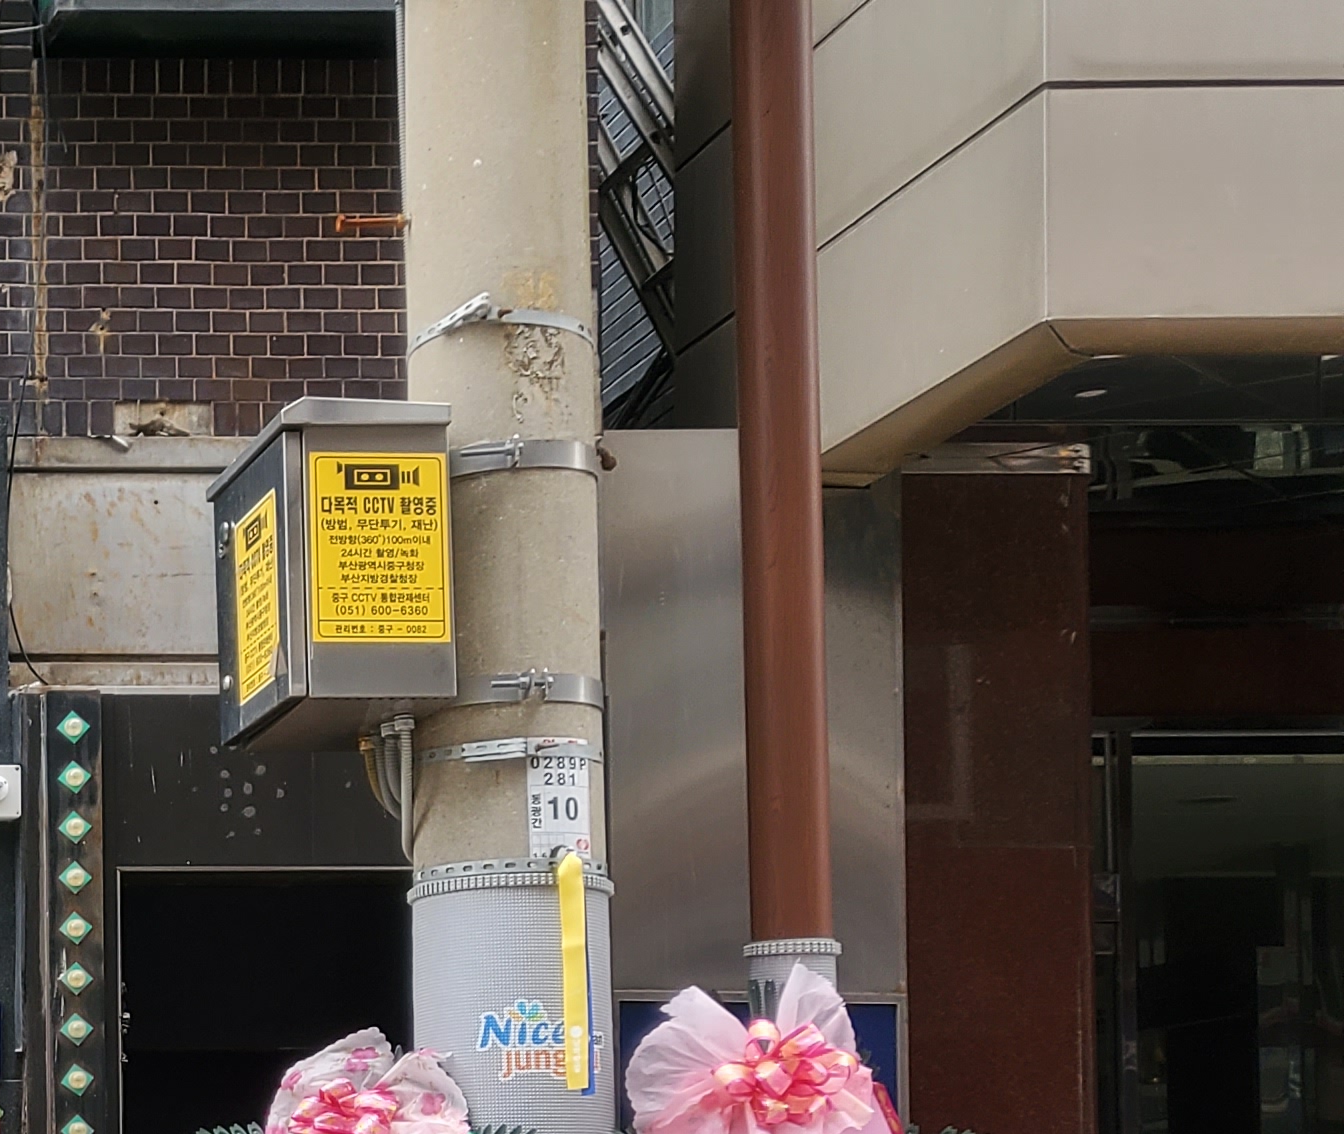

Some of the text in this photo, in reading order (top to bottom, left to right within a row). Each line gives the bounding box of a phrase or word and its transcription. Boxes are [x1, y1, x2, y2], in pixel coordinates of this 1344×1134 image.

[321, 496, 437, 516] 다목적 CCTV 촬영중
[321, 518, 439, 532] (방범, 무단투기, 재난)
[340, 548, 373, 559] 24시간
[338, 561, 425, 572] 부산광역시중구청장
[340, 573, 418, 584] 부산지방경찰청장
[332, 592, 430, 604] 중구 CCTV 통합관제센터
[335, 605, 429, 617] (051) 600-6360
[335, 624, 366, 634] 관리번호
[543, 772, 577, 786] 281
[547, 796, 579, 821] 10
[479, 1013, 566, 1049] Nice
